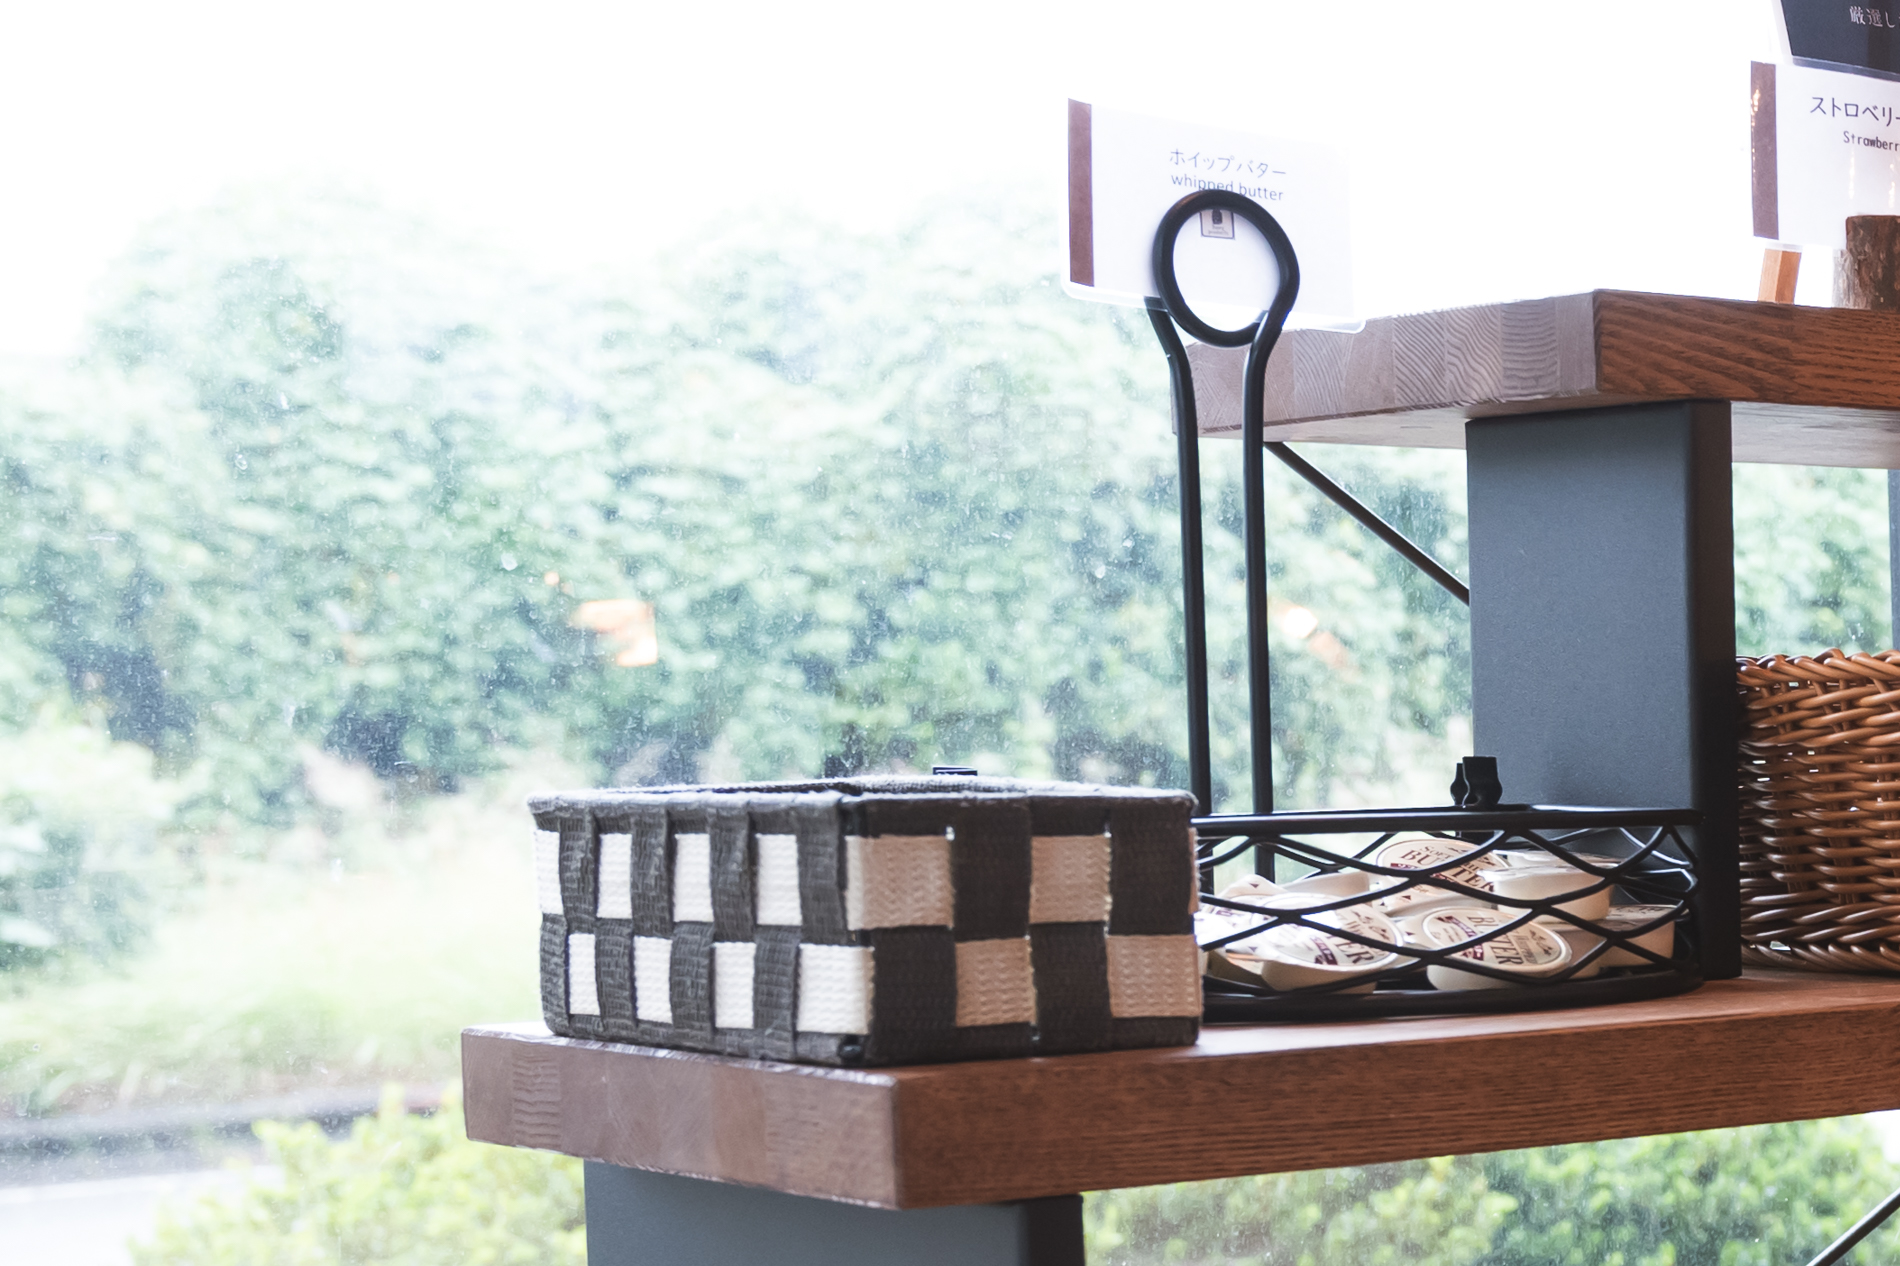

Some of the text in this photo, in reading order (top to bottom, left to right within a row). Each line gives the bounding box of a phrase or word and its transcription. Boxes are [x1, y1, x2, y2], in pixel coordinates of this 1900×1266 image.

[1169, 148, 1287, 178] ホイップバター
[1171, 173, 1284, 201] whipped butter
[1399, 849, 1495, 893] BUTER
[1465, 915, 1524, 965] BTER
